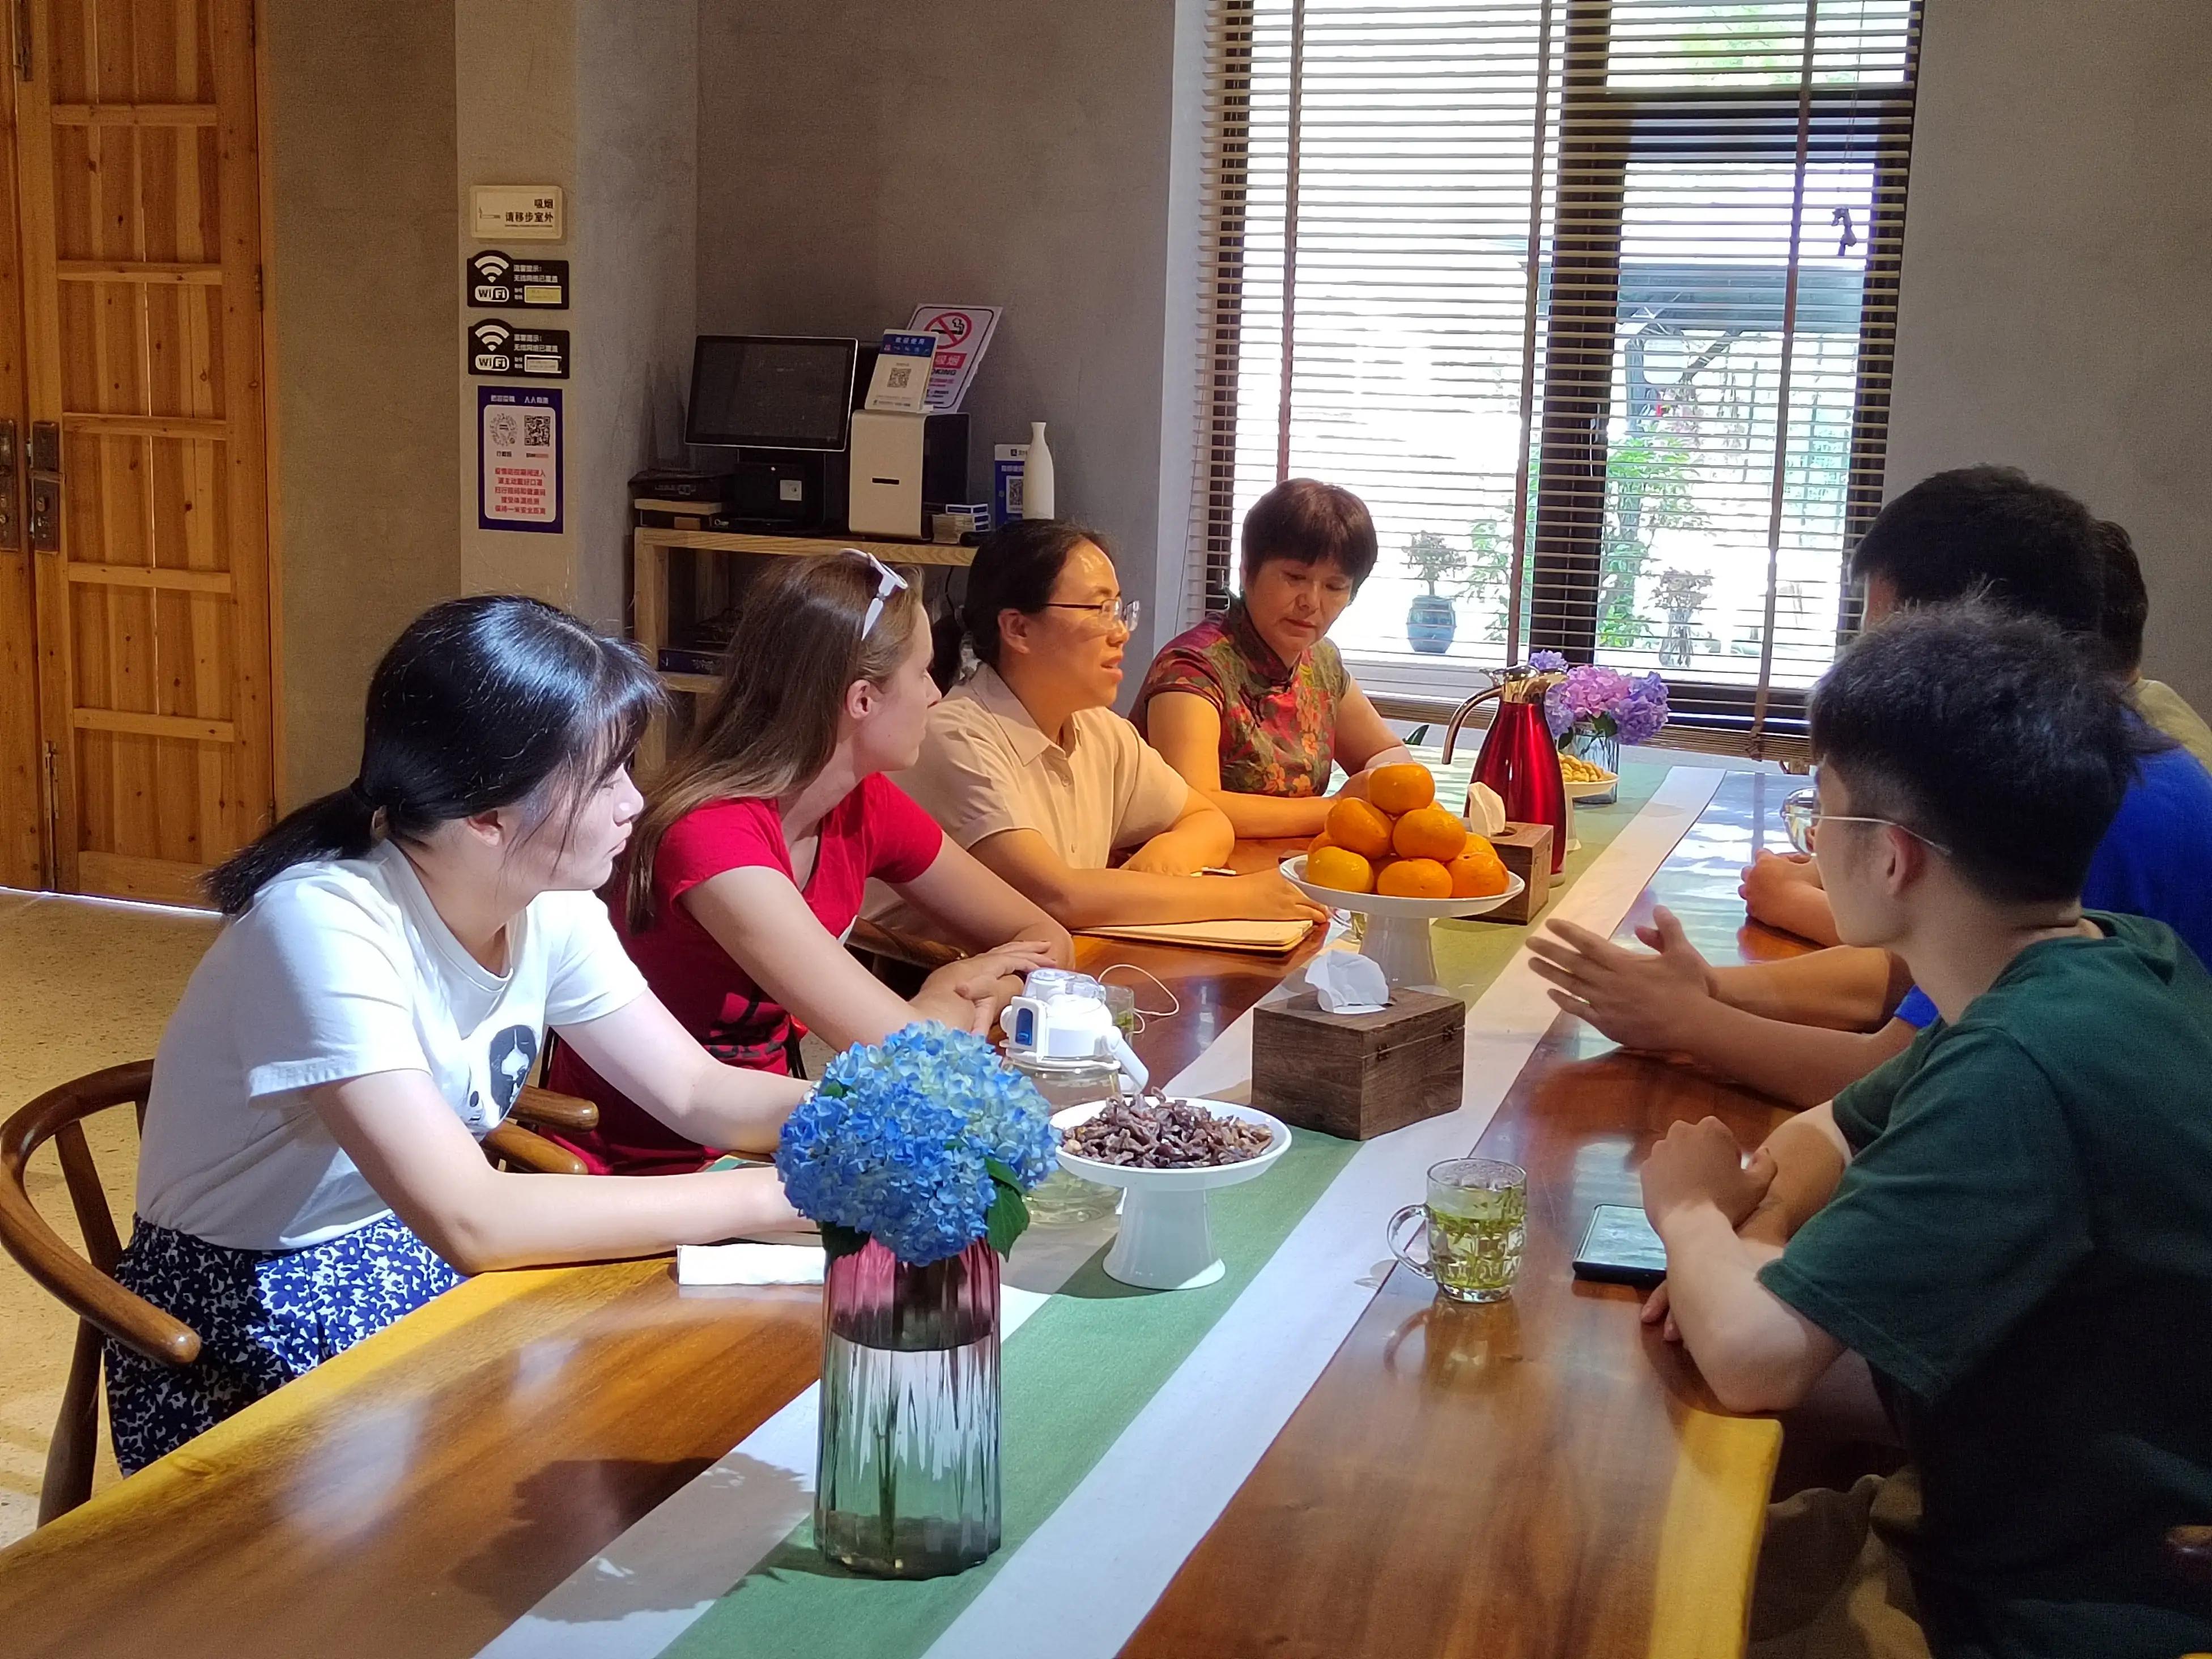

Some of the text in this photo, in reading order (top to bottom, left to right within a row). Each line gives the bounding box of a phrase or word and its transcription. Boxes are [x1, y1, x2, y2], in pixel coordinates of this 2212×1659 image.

[534, 199, 554, 209] 吸烟
[506, 211, 554, 223] 请移步室外
